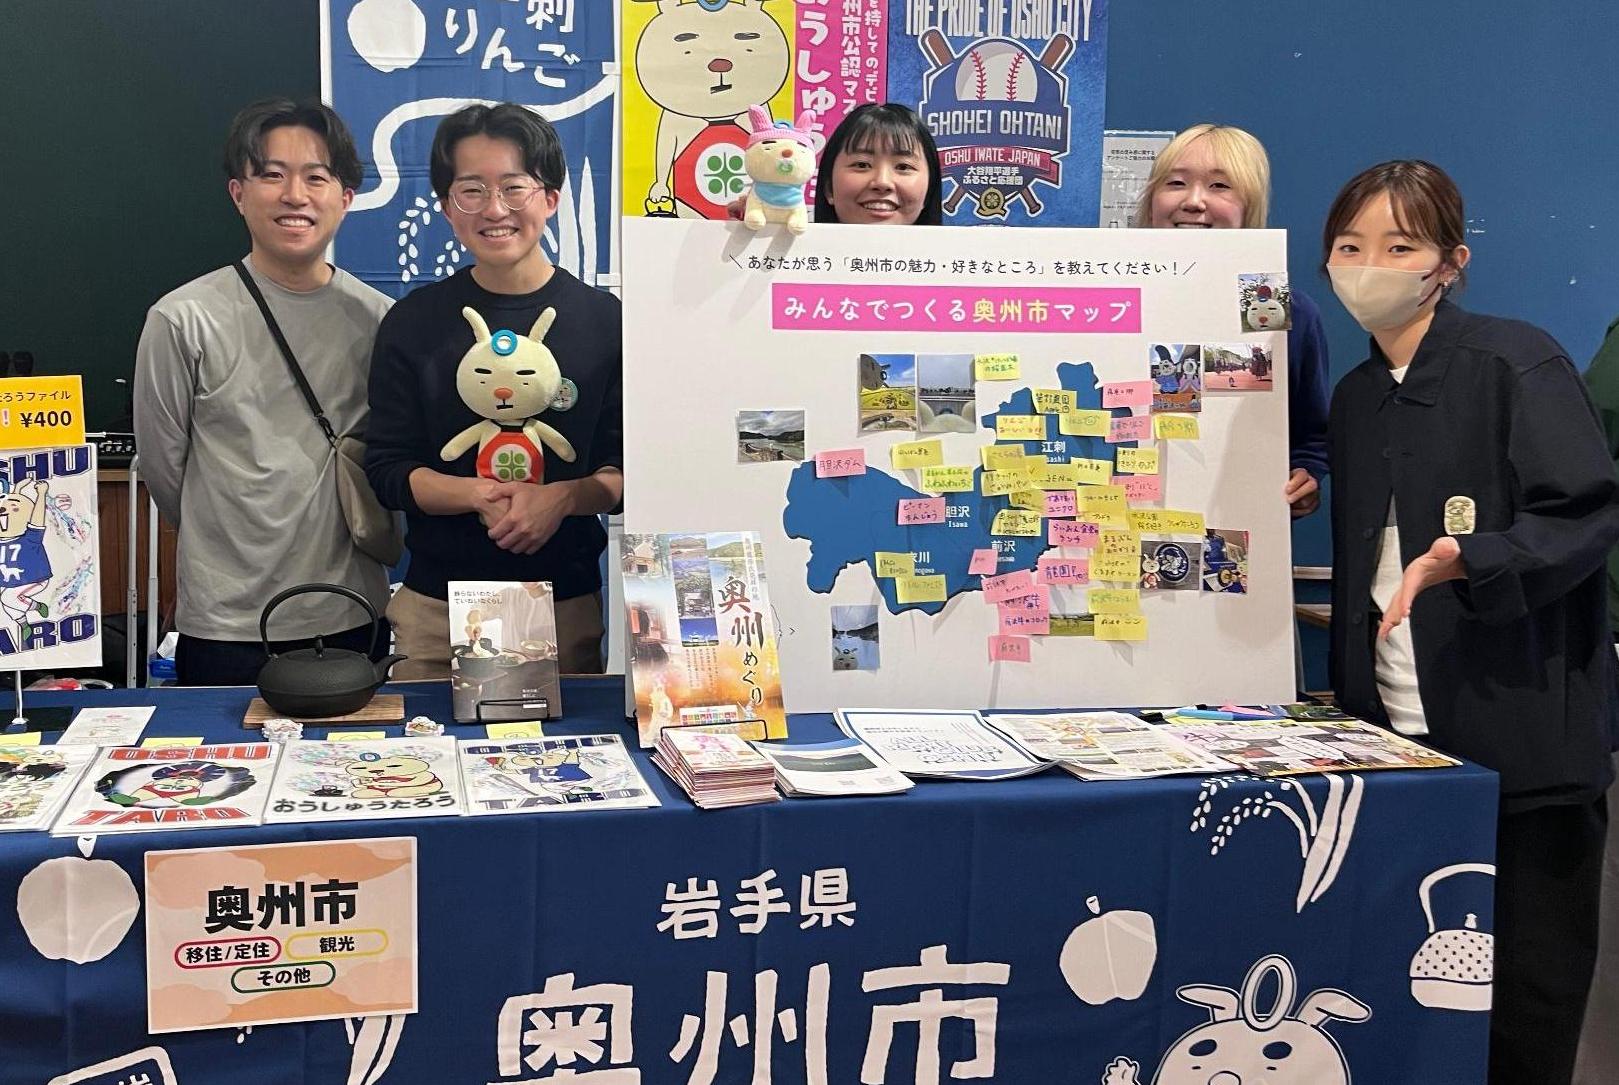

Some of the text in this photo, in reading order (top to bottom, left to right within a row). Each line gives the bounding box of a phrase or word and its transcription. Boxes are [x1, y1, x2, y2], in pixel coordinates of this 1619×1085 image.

[512, 0, 588, 33] 刺
[445, 9, 582, 89] りんご
[927, 109, 1062, 140] SHOHEI OHTANI
[944, 148, 1041, 167] OSHU IWATE JAPAN
[962, 175, 1024, 186] ふるさと応援団
[967, 166, 1020, 176] 大谷翔平選手
[783, 296, 1132, 325] みんなでつくる奥州市マップ
[19, 410, 72, 428] ¥400
[1041, 441, 1067, 453] 江刺
[0, 446, 91, 483] HU
[819, 457, 862, 471] 胆沢ダム
[946, 505, 971, 518] 胆沢
[991, 541, 1016, 553] 前沢
[717, 575, 765, 704] 奥州めぐり
[272, 797, 456, 814] おうしゅうたろう
[204, 879, 359, 933] 奥州市
[656, 867, 857, 939] 岩手県
[186, 936, 355, 963] 移住/定住 観光
[257, 967, 311, 985] その他
[486, 945, 1012, 1085] 奥州市
